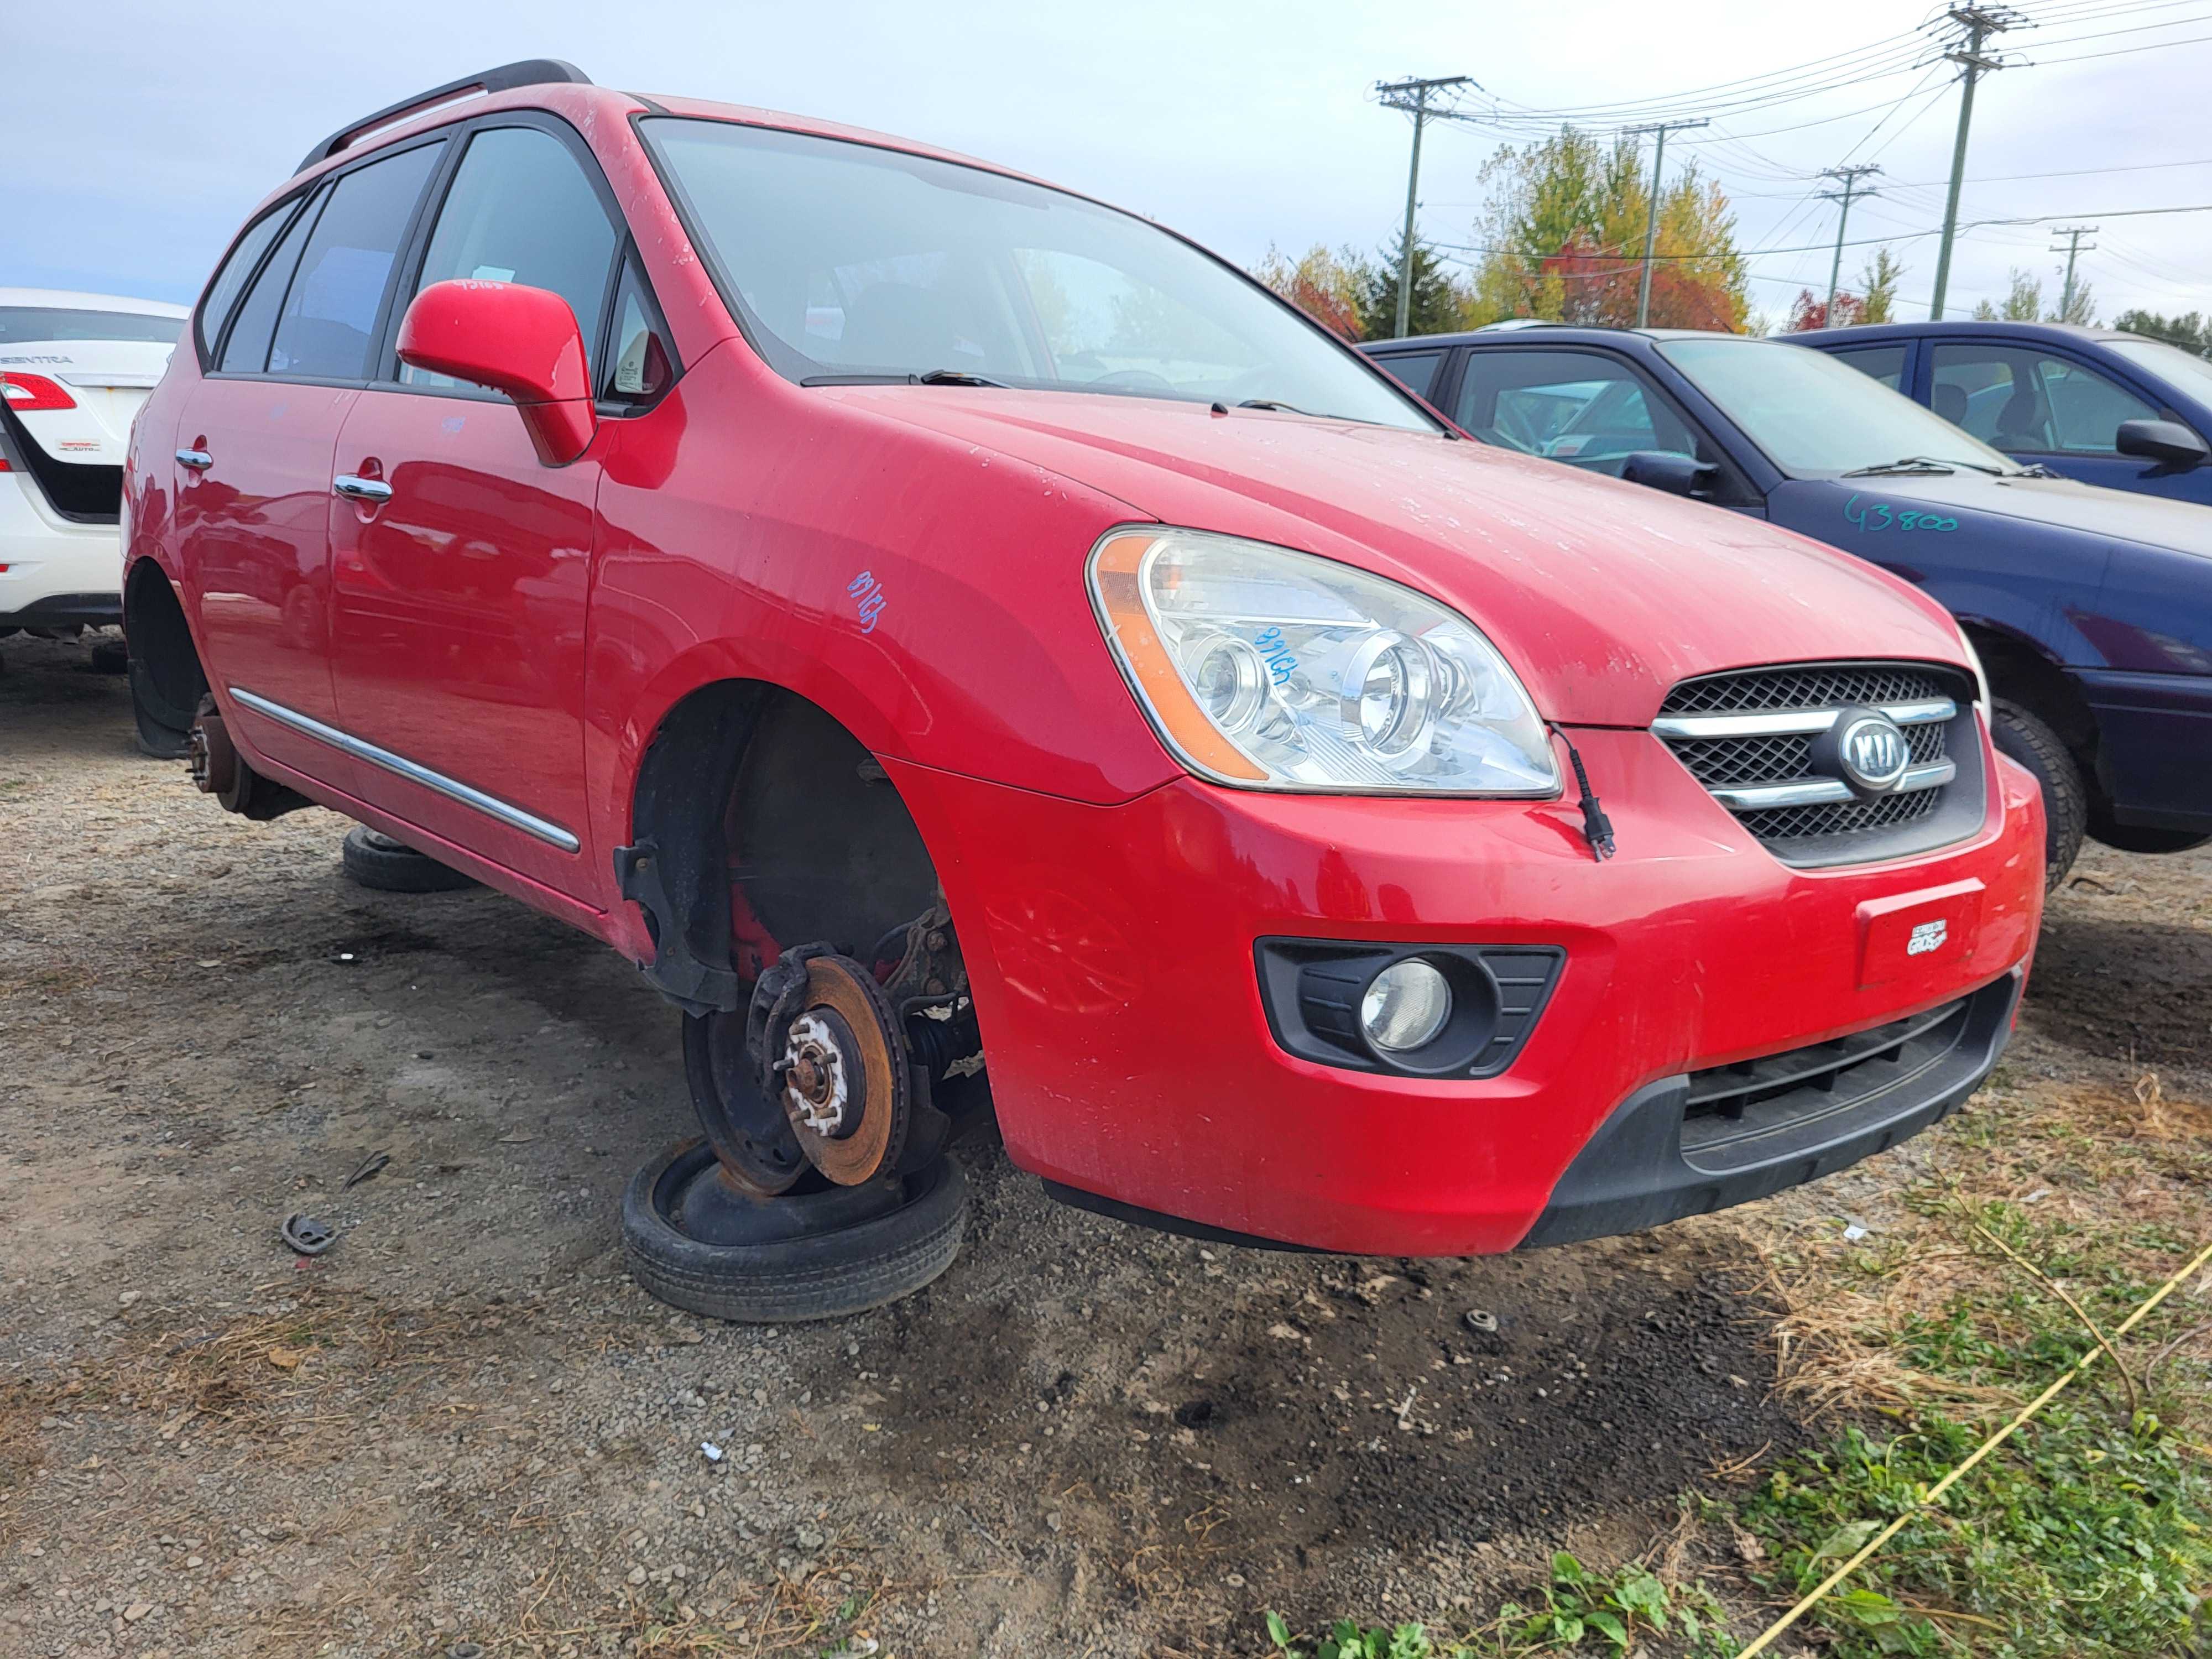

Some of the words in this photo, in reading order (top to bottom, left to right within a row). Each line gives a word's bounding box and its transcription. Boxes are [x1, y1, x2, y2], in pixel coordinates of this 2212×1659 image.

[0, 356, 74, 364] SENTRA
[1843, 494, 1959, 531] 43800
[1854, 733, 1901, 772] KIA
